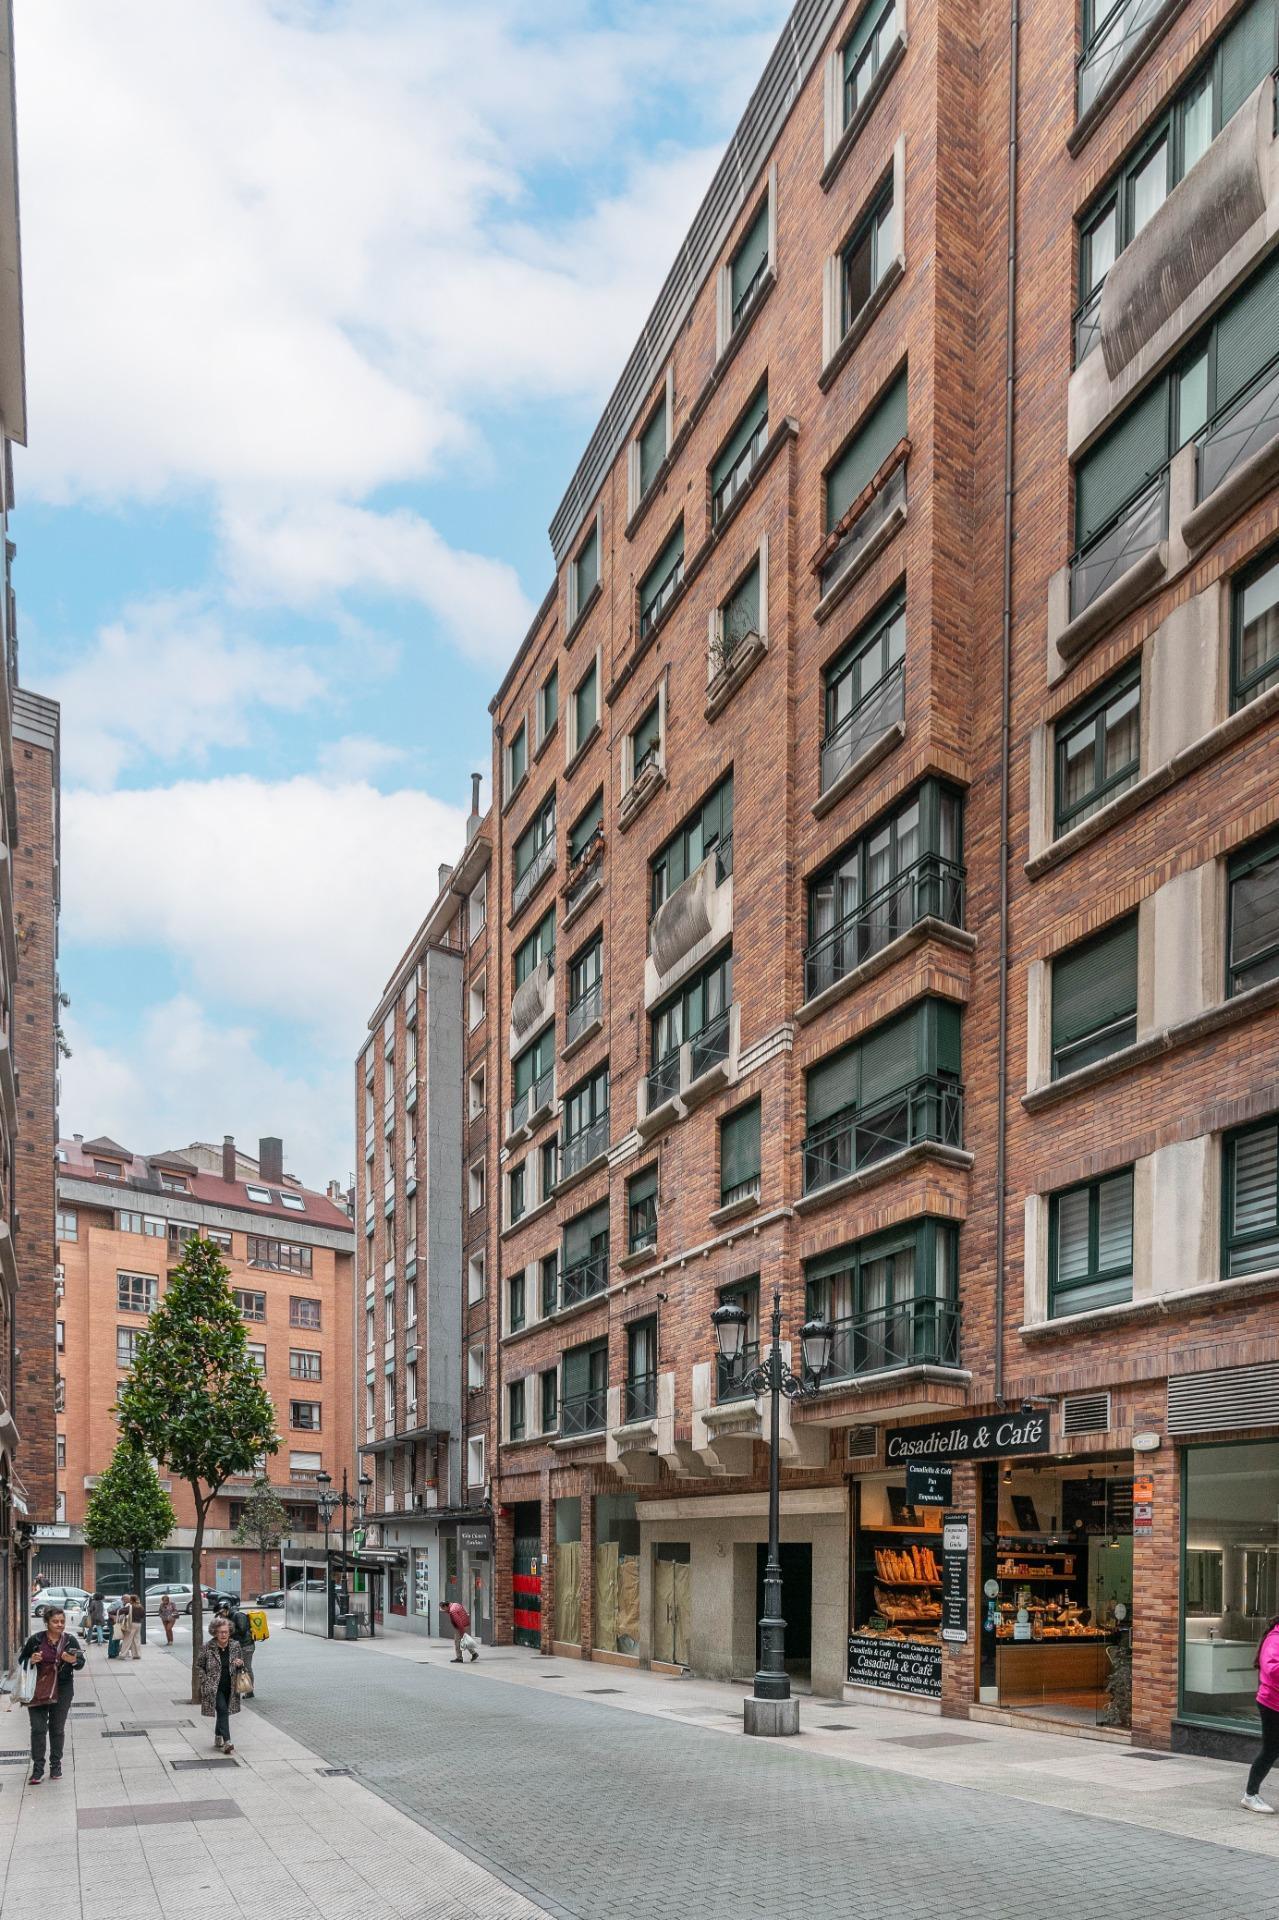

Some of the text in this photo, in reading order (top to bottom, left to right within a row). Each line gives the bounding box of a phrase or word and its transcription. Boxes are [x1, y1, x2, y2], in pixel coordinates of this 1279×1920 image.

[888, 1419, 1043, 1457] Casadiella & Café
[858, 1655, 934, 1676] Casadiella & Café
